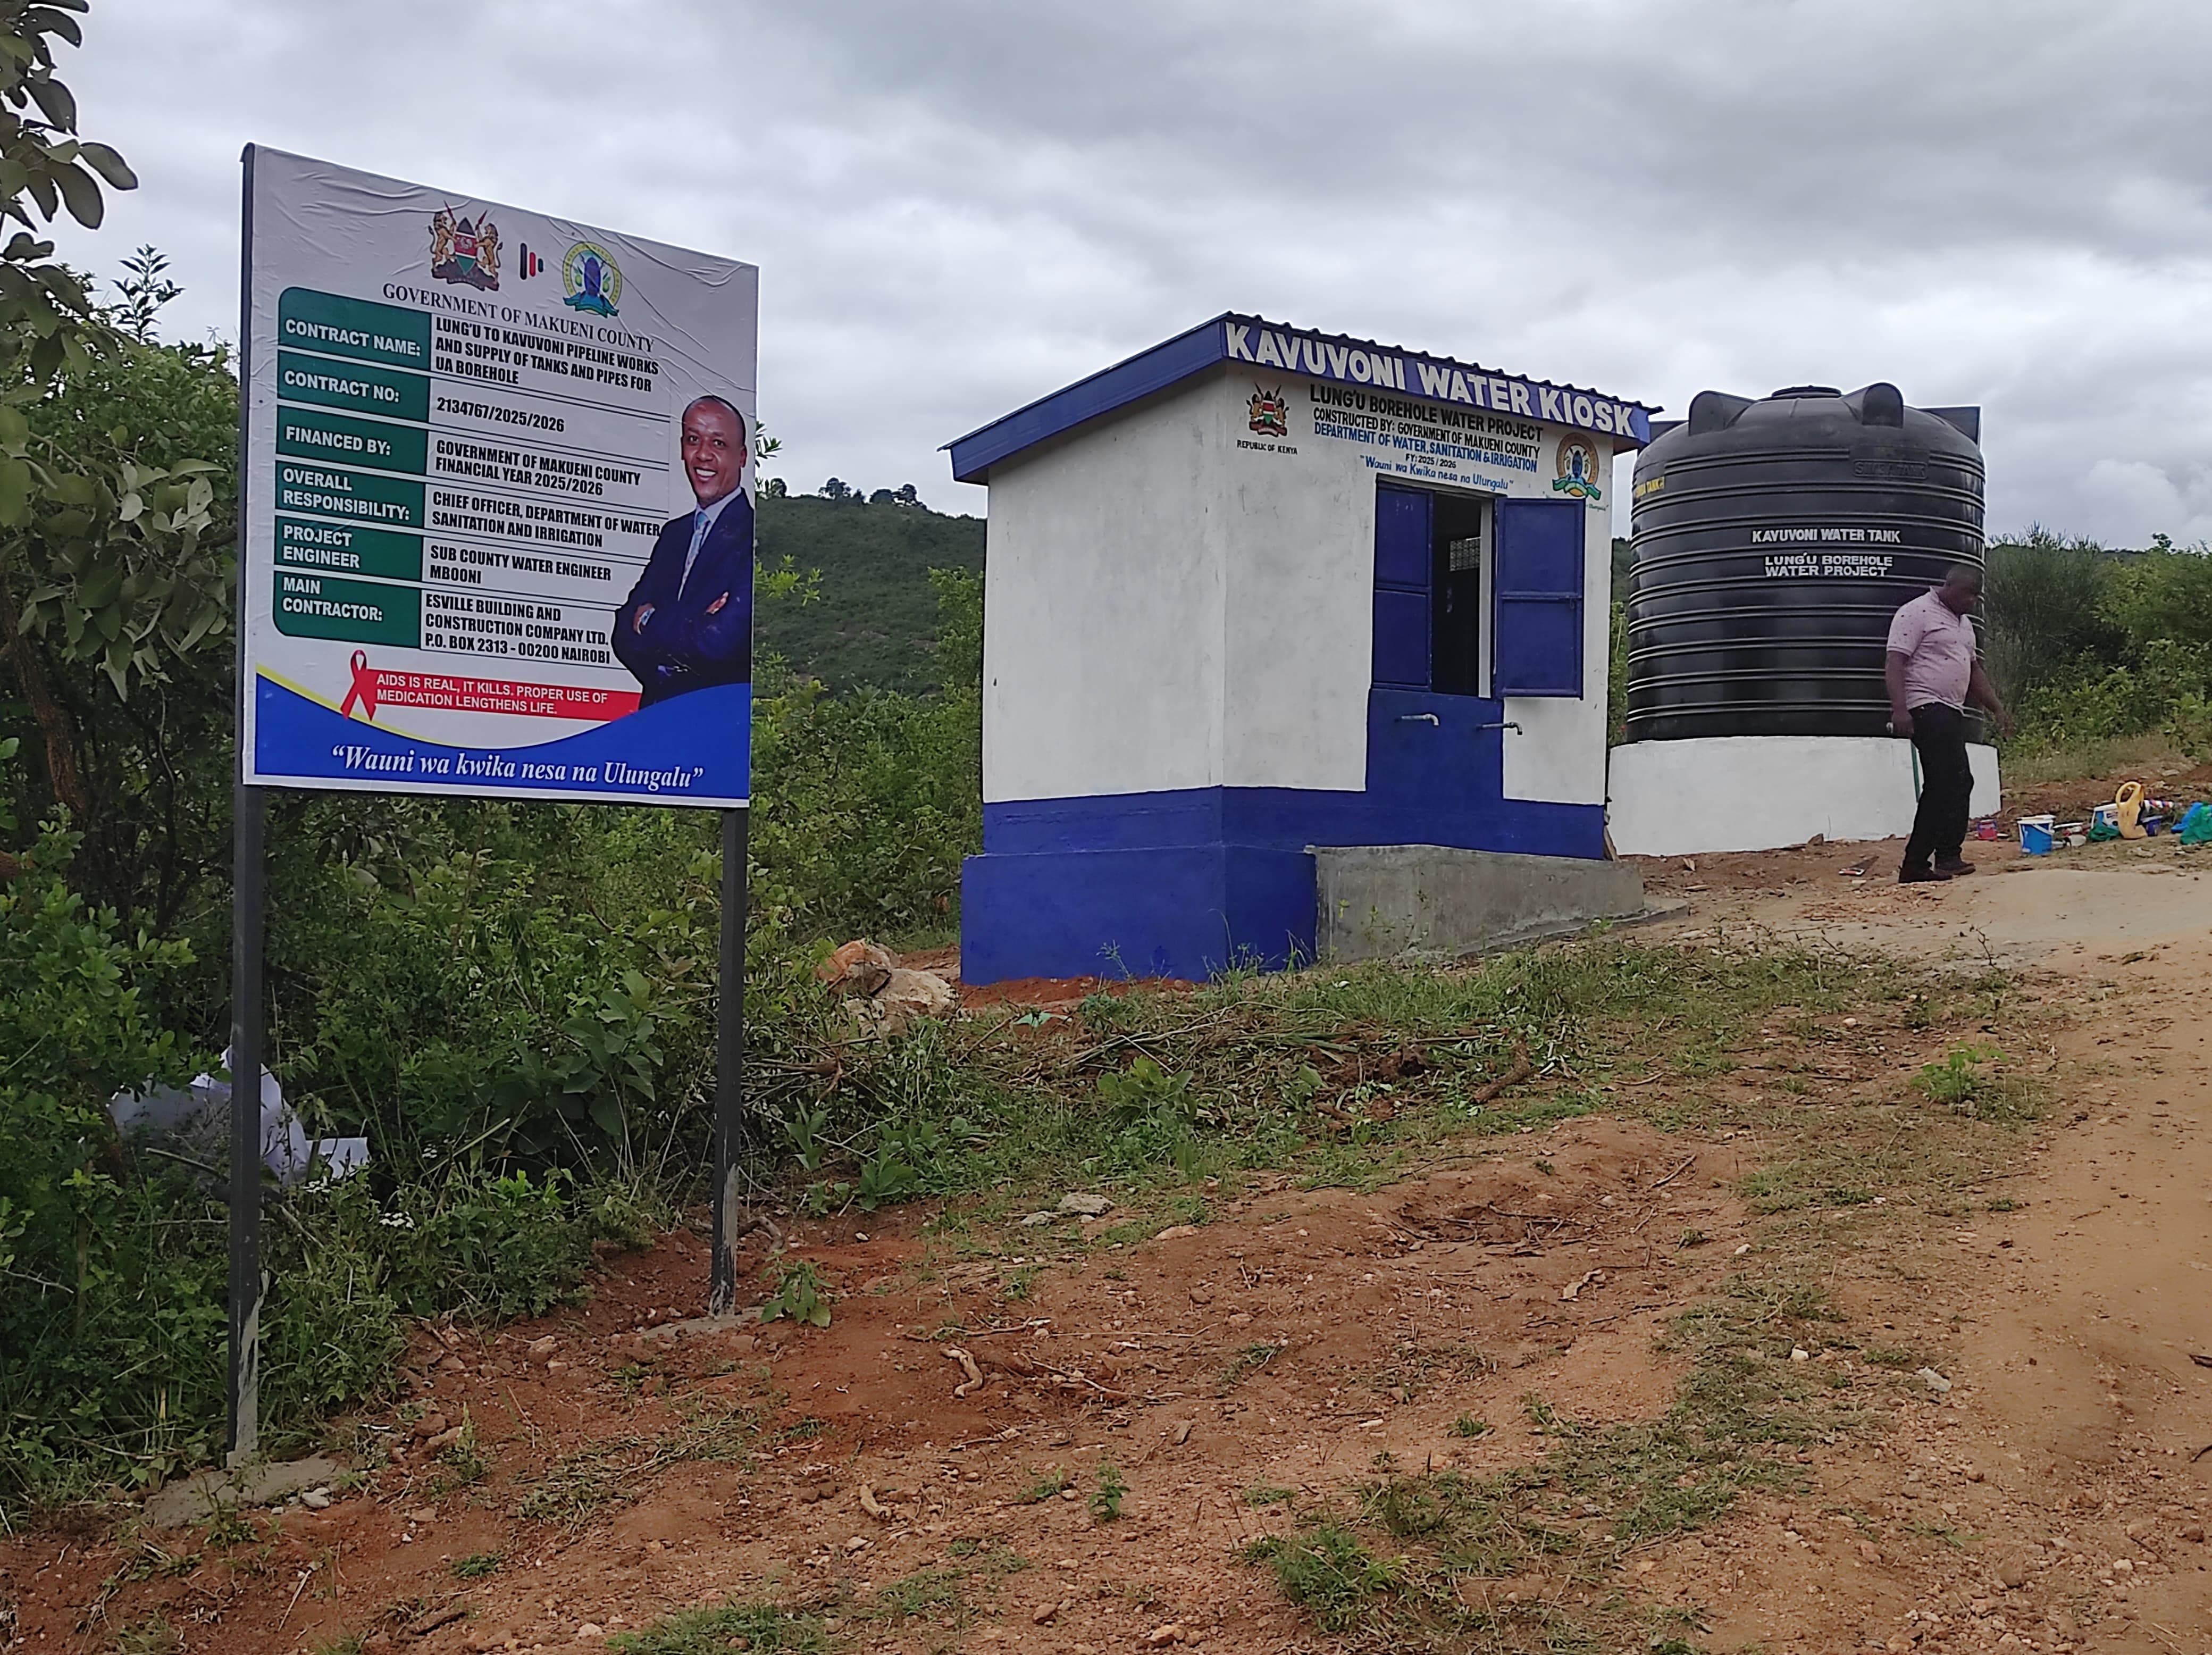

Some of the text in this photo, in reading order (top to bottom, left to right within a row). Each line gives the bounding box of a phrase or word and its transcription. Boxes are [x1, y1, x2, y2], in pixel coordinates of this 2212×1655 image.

[383, 283, 498, 319] GOVERNMENT
[501, 307, 522, 324] OF
[525, 311, 594, 340] MAKUENI
[597, 327, 655, 353] COUNTY
[286, 319, 421, 356] CONTRACT NAME:
[436, 317, 659, 375] LUNG'U TO KAVUVONI PIPELINE WORKS
[435, 337, 652, 392] AND SUPPLY OF TANKS AND PIPES FOR
[435, 356, 520, 385] UA BOREHOLE
[1226, 321, 1636, 438] KAVUVONI WATER KIOSK
[284, 371, 399, 403] CONTRACT NO:
[437, 397, 565, 432] 2134767/2025/2026
[1310, 384, 1544, 442] LUNG'U BOREHOLE WATER PROJECT
[286, 425, 391, 456] FINANCED BY:
[1237, 439, 1267, 451] REPUBLIC
[1278, 445, 1297, 455] KENYA
[1313, 407, 1540, 459] CONSTRUCTED BY: GOVERNMENT OF MAKUENI COUNTY
[1314, 422, 1376, 444] DEPARTMENT
[1378, 433, 1392, 446] OF
[435, 457, 604, 496] FINANCIAL YEAR 2025/2026
[437, 440, 641, 486] GOVERNMENT OF MAKUENI COUNTY
[1396, 464, 1407, 473] wa
[1410, 463, 1436, 478] Kwika
[1438, 472, 1457, 482] nesa
[1461, 475, 1470, 483] na
[283, 469, 353, 491] OVERALL
[283, 490, 409, 521] RESPONSIBILITY:
[433, 491, 660, 537] CHIEF OFFICER, DEPARTMENT OF WATER
[283, 525, 353, 547] PROJECT
[432, 511, 603, 547] SANITATION AND IRRIGATION
[1752, 528, 1901, 543] KAVUVONI WATER TANK
[283, 545, 360, 569] ENGINEER
[430, 545, 611, 581] SUB COUNTY WATER ENGINEER
[1765, 552, 1893, 566] LUNG'U BOREHOLE
[1765, 565, 1888, 576] WATER PROJECT
[283, 577, 321, 594] MAIN
[430, 565, 482, 584] MBOONI
[282, 597, 382, 621] CONTRACTOR:
[425, 594, 562, 622] ESVILLE BUILDING AND
[425, 613, 609, 646] CONSTRUCTION COMPANY LTD.
[425, 633, 446, 648] P.O.
[449, 635, 475, 651] BOX
[477, 638, 508, 654] 2313
[518, 642, 559, 659] 00200
[561, 646, 610, 664] NAIROBI
[376, 673, 608, 704] AIDS IS REAL, IT KILLS. PROPER USE OF
[376, 689, 558, 714] MEDICATION LENGTHENS LIFE.
[420, 757, 449, 774] wa
[455, 753, 515, 779] kwika
[521, 763, 566, 781] nesa
[572, 766, 597, 782] na
